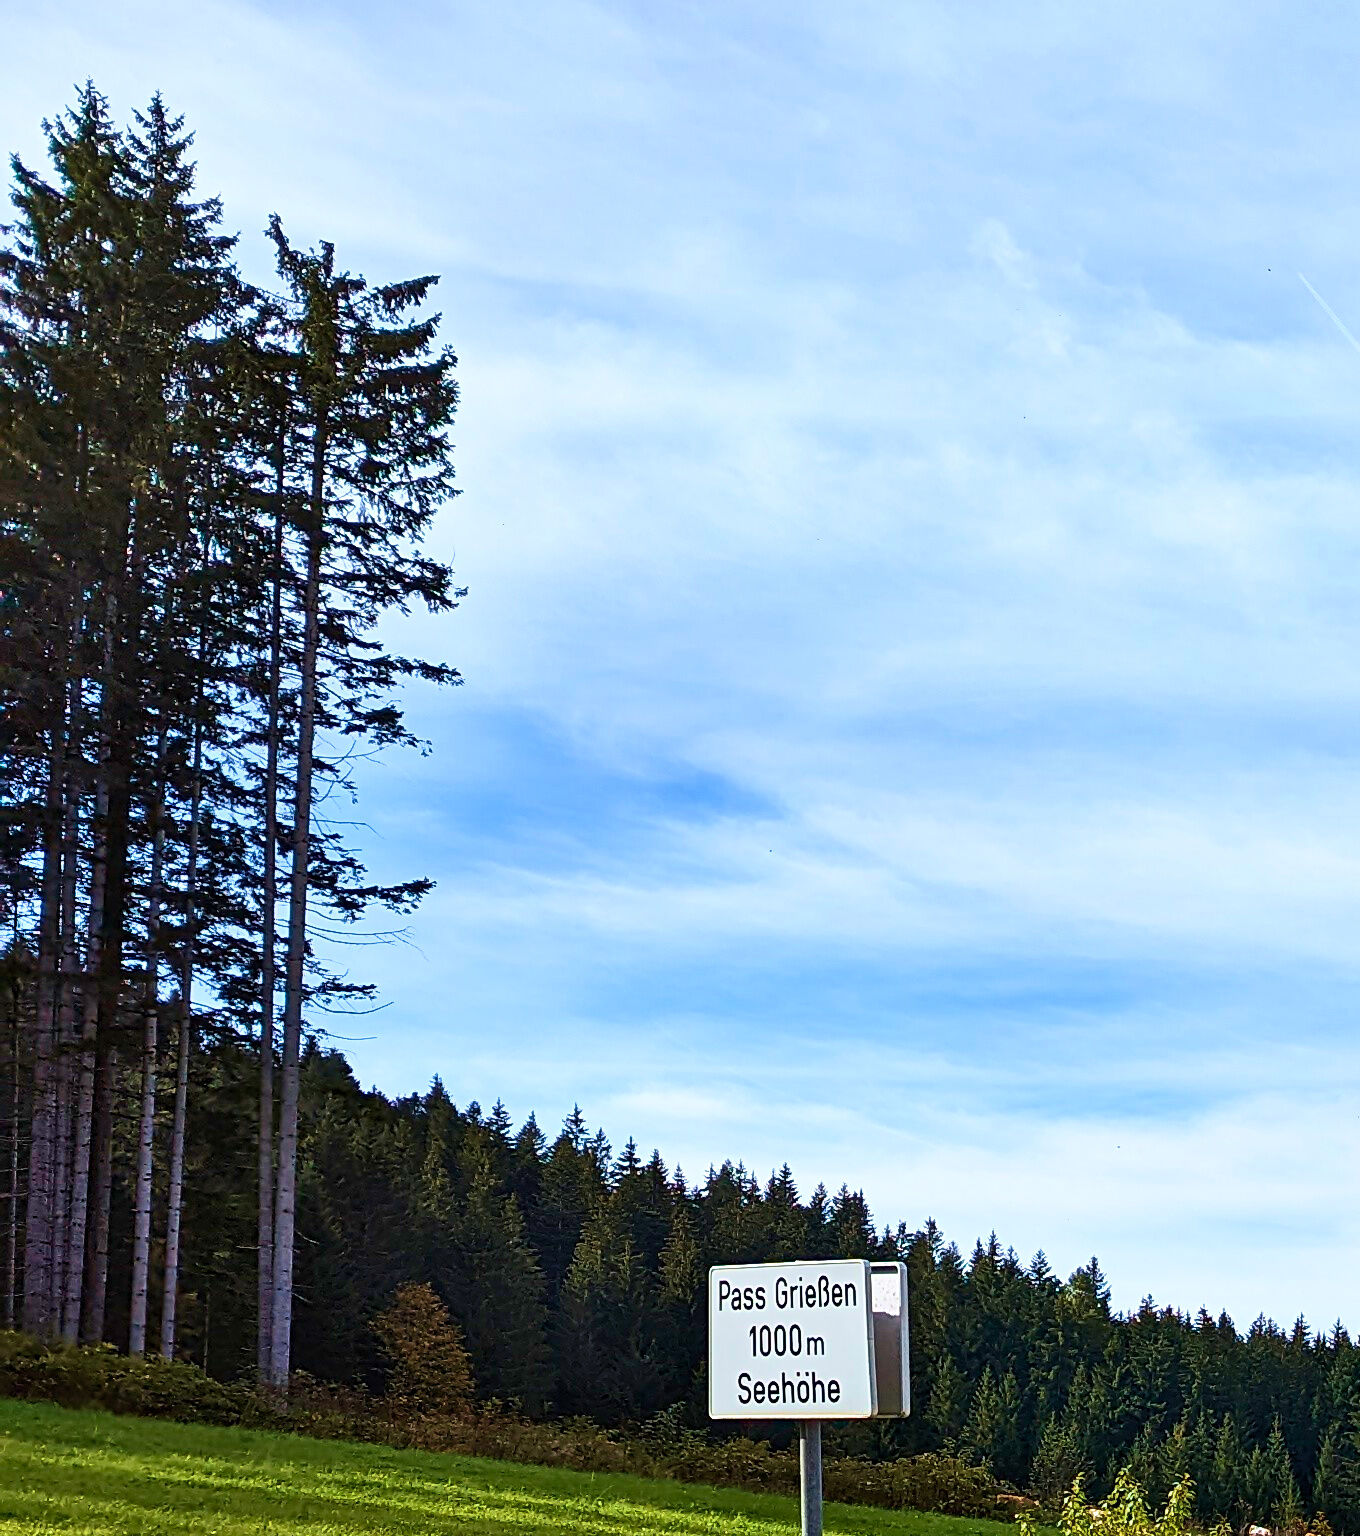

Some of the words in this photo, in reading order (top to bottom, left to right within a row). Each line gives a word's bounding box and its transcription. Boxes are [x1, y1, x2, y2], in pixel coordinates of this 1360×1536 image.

[719, 1280, 766, 1311] Pass
[775, 1275, 857, 1309] Grießen
[749, 1323, 801, 1357] 1000
[806, 1335, 825, 1355] m
[738, 1371, 841, 1404] Seehöhe
